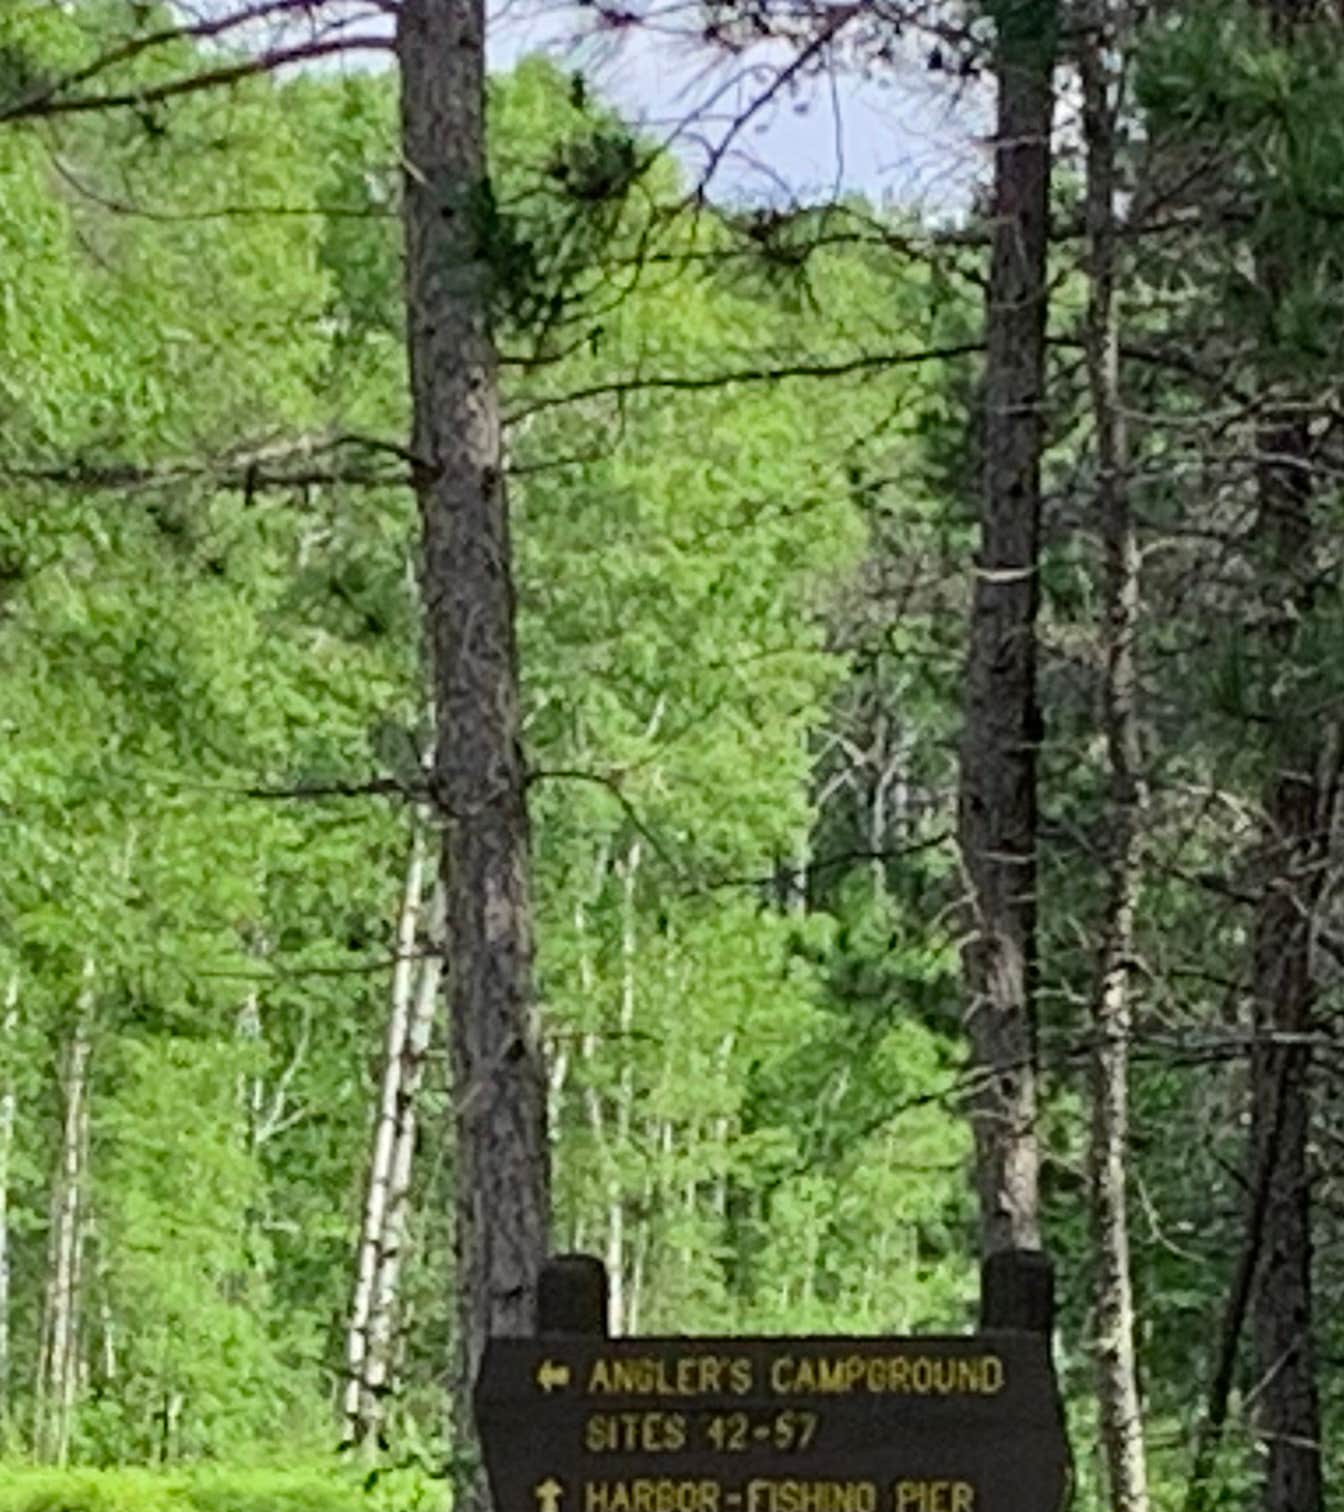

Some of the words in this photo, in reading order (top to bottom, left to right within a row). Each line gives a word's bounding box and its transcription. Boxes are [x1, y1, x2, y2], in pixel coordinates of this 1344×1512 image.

[589, 1357, 752, 1394] ANGLER'S
[771, 1355, 1004, 1395] CAMPGROUND
[586, 1412, 686, 1451] SITES
